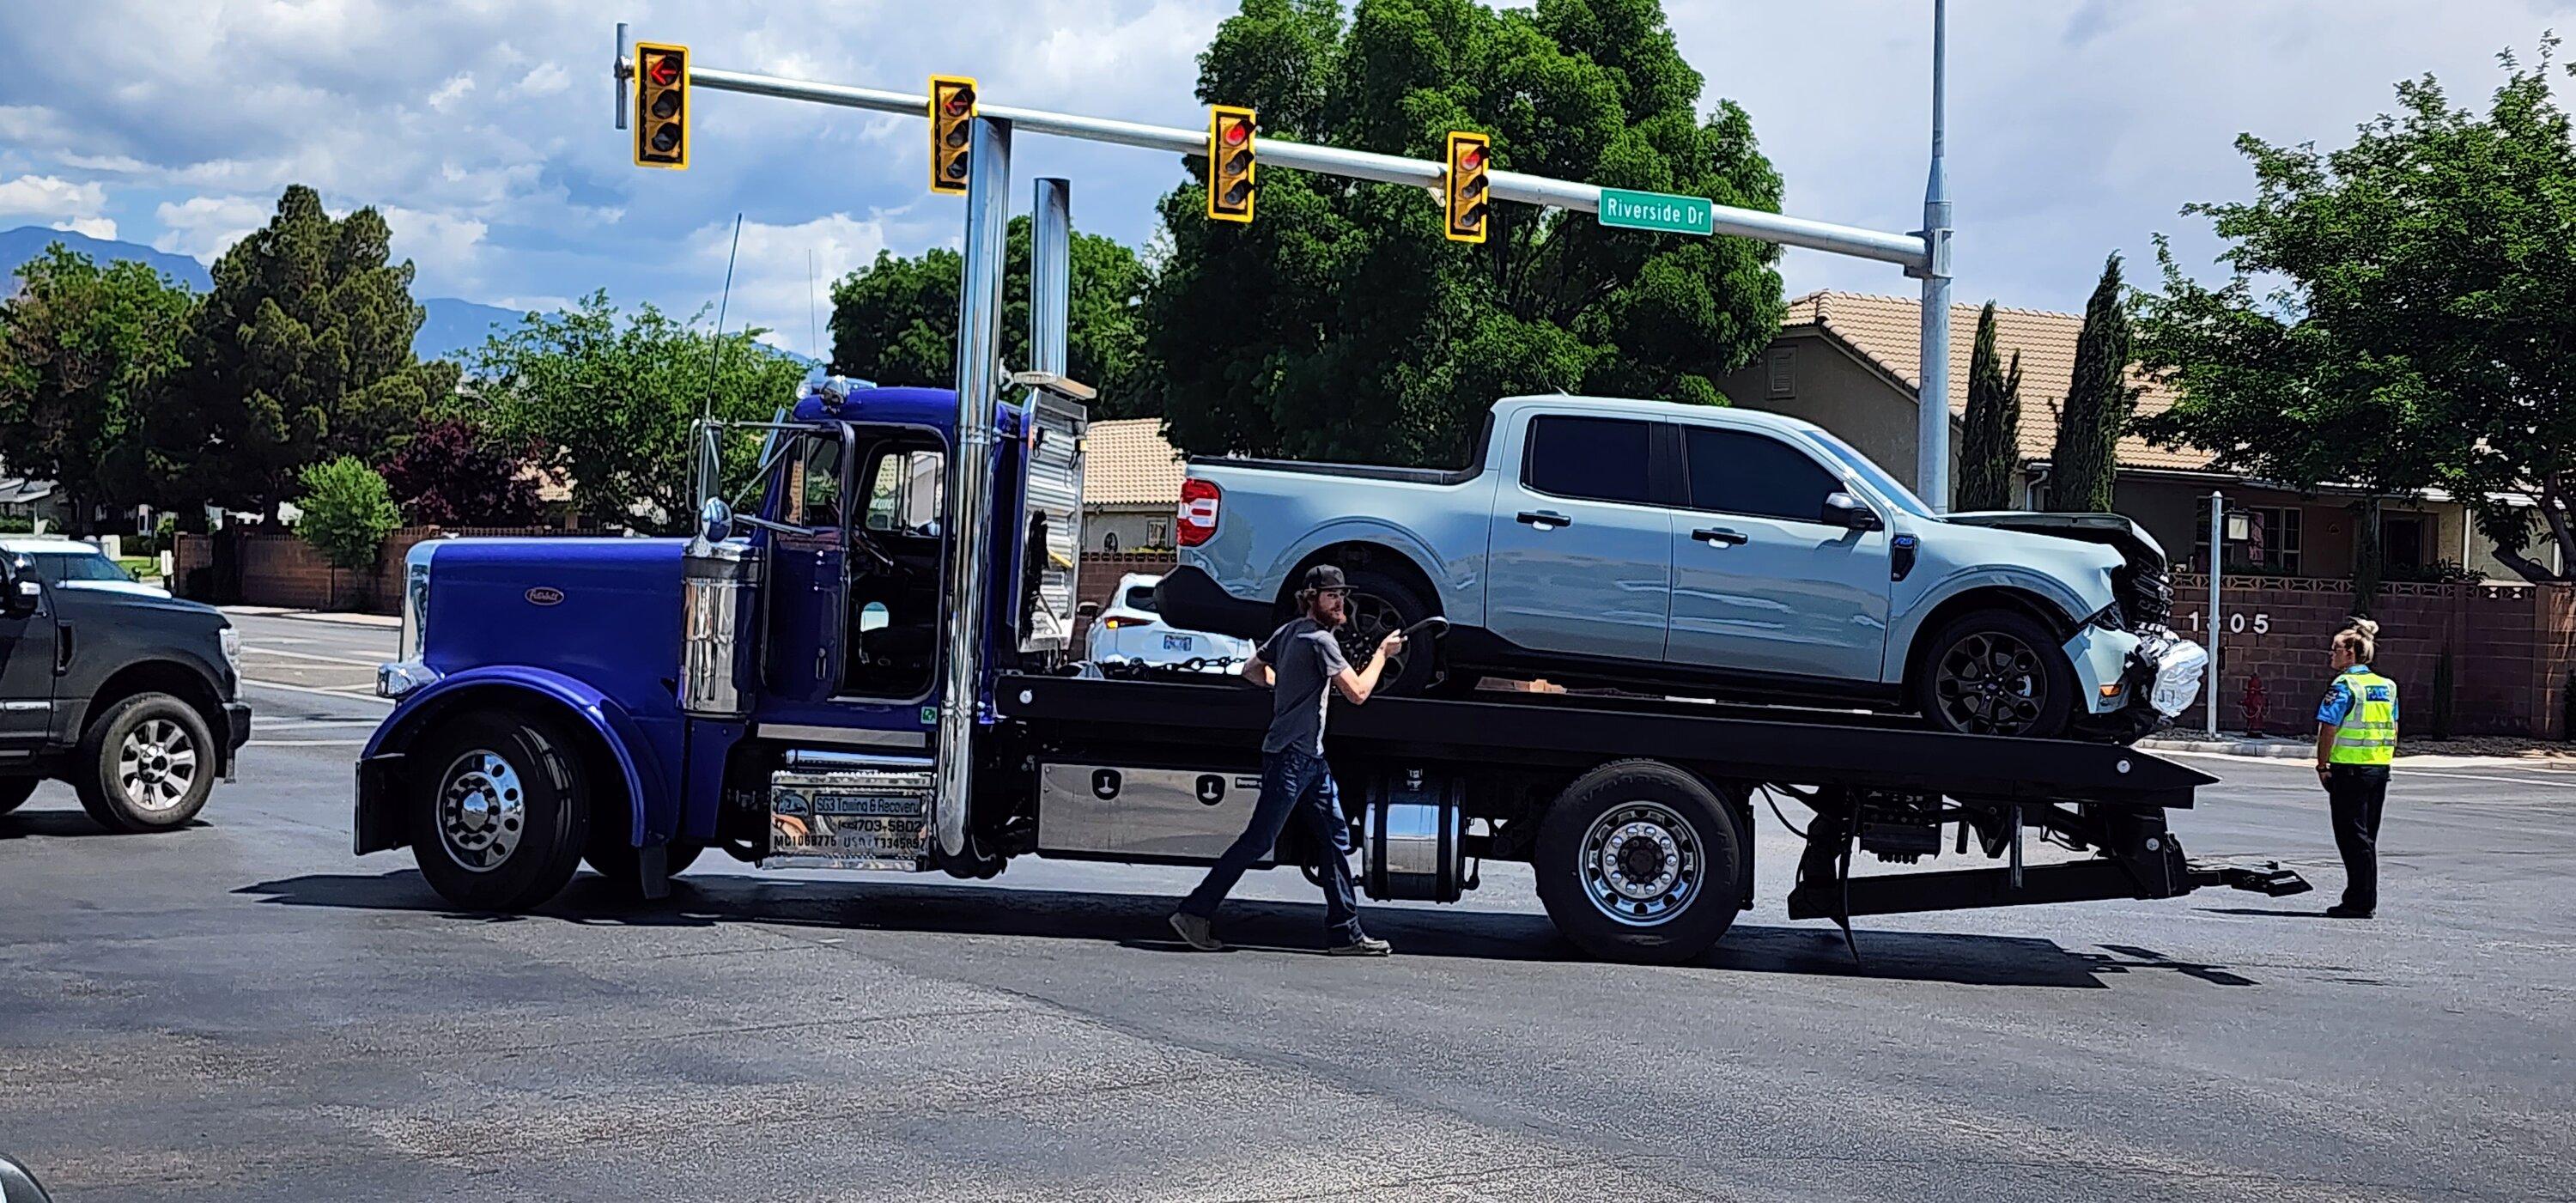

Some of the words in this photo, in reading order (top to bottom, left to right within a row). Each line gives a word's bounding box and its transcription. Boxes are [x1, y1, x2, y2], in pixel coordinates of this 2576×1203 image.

[1608, 197, 1680, 222] Riverside
[1688, 206, 1704, 225] Dr
[2188, 611, 2269, 635] 105
[878, 799, 920, 814] Recovery
